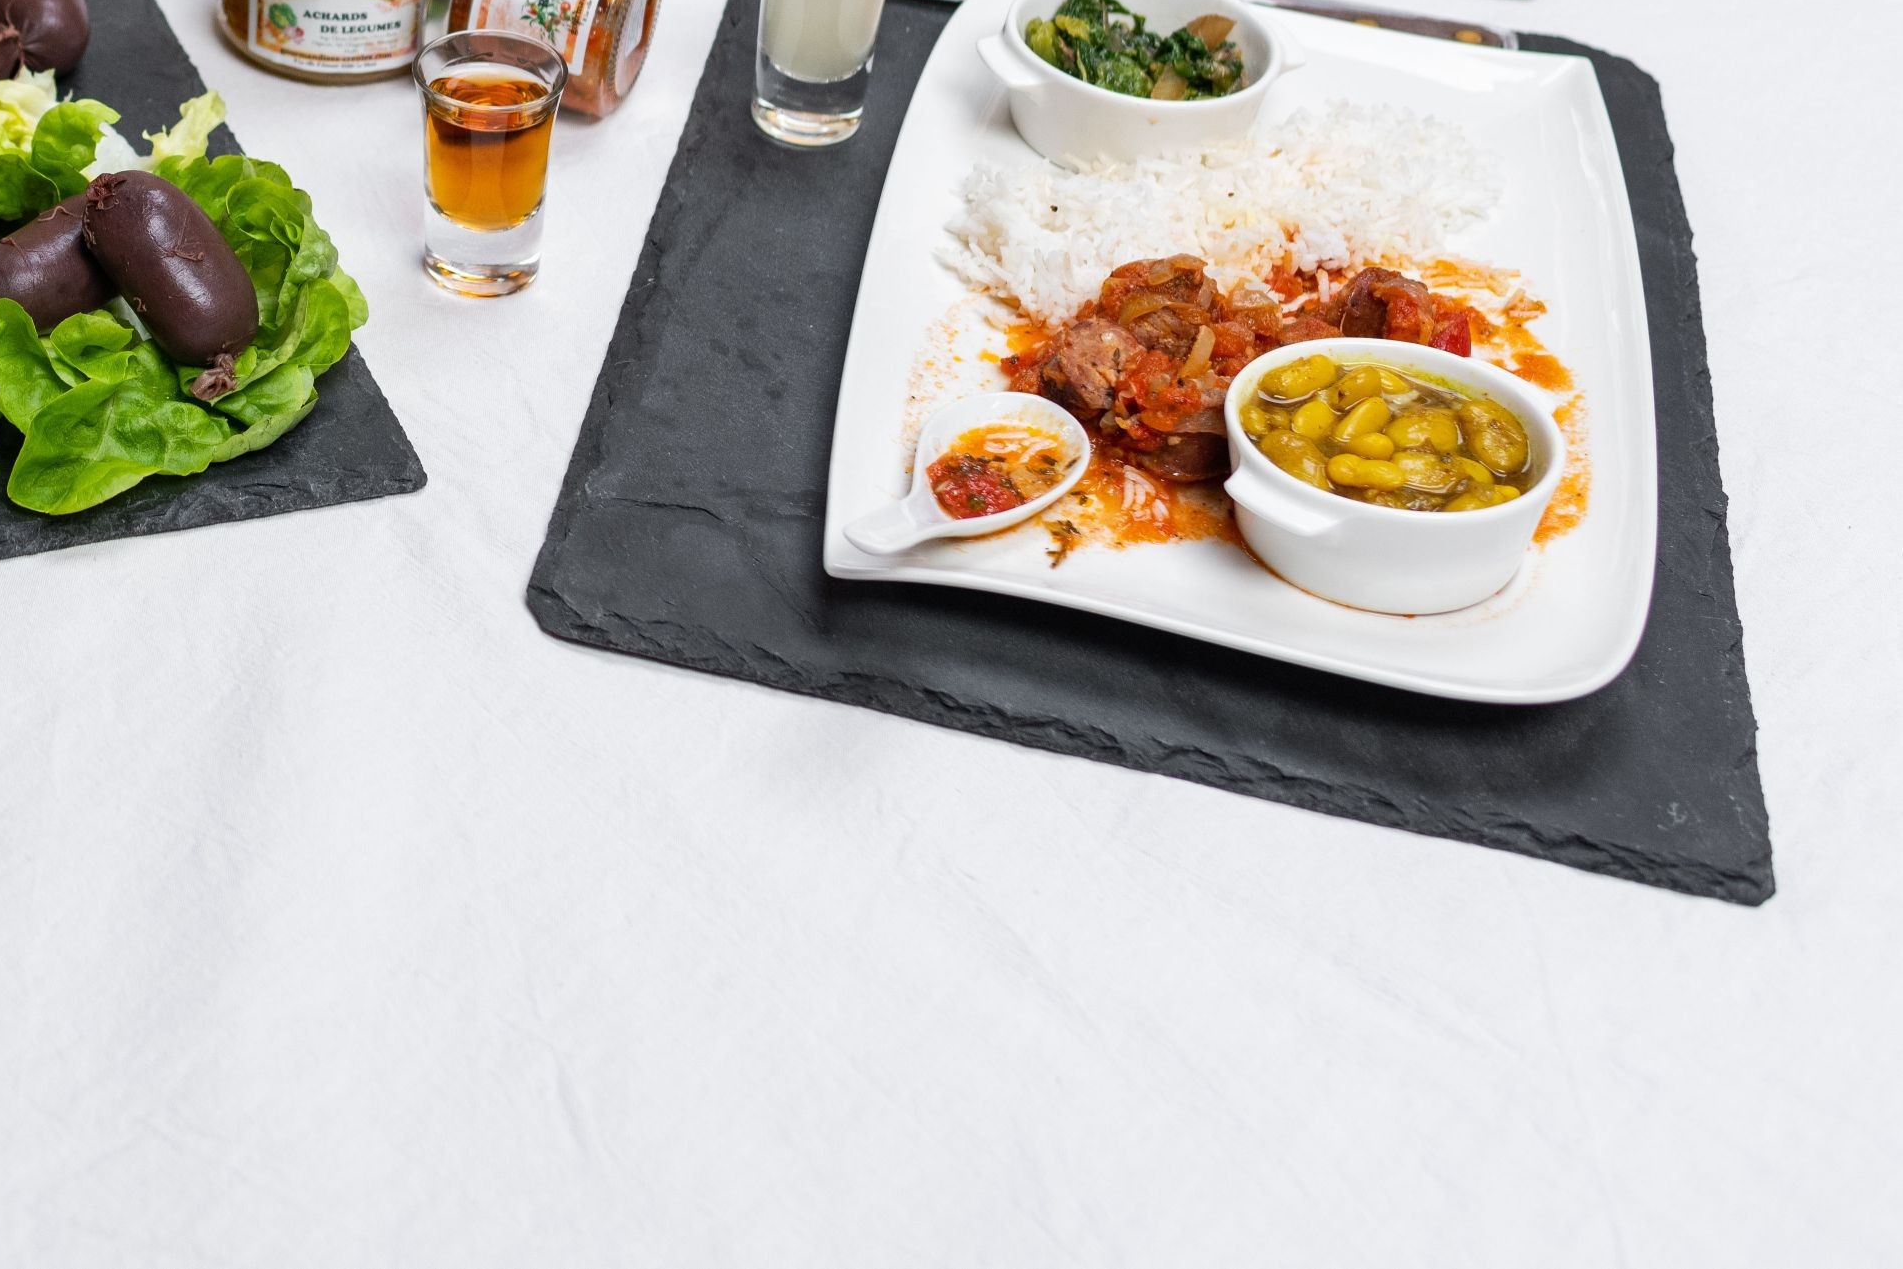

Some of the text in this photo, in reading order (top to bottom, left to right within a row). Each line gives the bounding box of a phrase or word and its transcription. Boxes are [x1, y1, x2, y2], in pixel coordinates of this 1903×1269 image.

[303, 9, 369, 22] ACHARDS
[320, 20, 402, 35] DE LEGUMES
